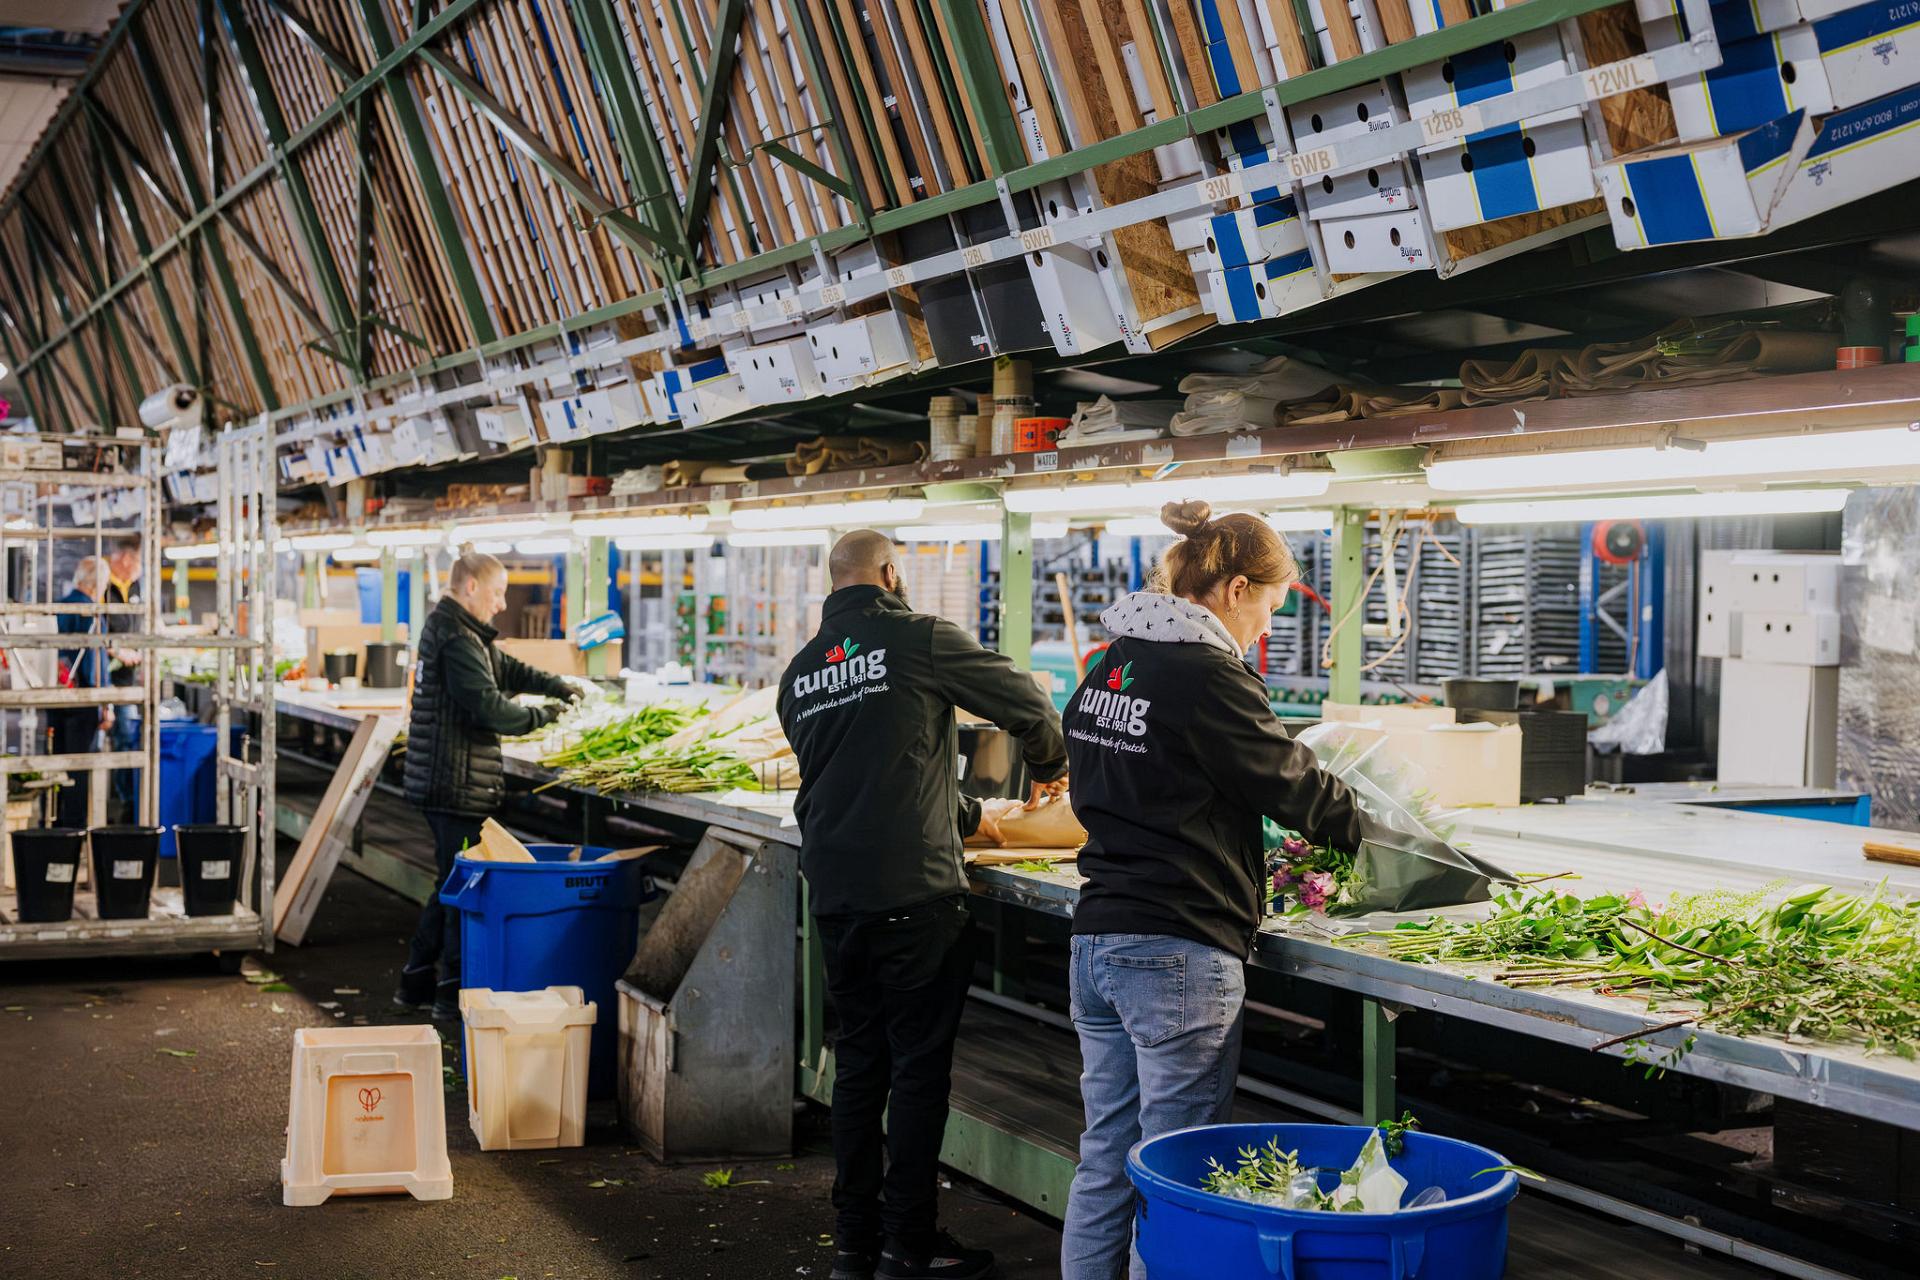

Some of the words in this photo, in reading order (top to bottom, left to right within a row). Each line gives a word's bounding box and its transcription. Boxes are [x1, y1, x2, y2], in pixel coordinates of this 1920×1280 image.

[1888, 1, 1920, 21] 6.1212
[1588, 63, 1645, 96] 12WL
[1424, 110, 1464, 136] 12BB
[1831, 110, 1893, 141] 800.676.1212
[1290, 150, 1331, 176] 6WB
[1205, 177, 1231, 201] 3W
[1023, 229, 1053, 250] 6WH
[963, 248, 986, 266] 12BL
[1036, 454, 1057, 467] WATER
[793, 648, 887, 698] tuning
[828, 681, 847, 694] EST.
[850, 673, 867, 686] 1931
[797, 713, 802, 722] A
[802, 698, 838, 719] Worldwide
[839, 690, 857, 705] touch
[857, 686, 864, 702] of
[864, 682, 889, 694] Dutch
[1079, 686, 1151, 736] tuning
[1096, 717, 1110, 729] EST.
[1111, 719, 1127, 733] 1931
[1121, 741, 1148, 754] Dutch
